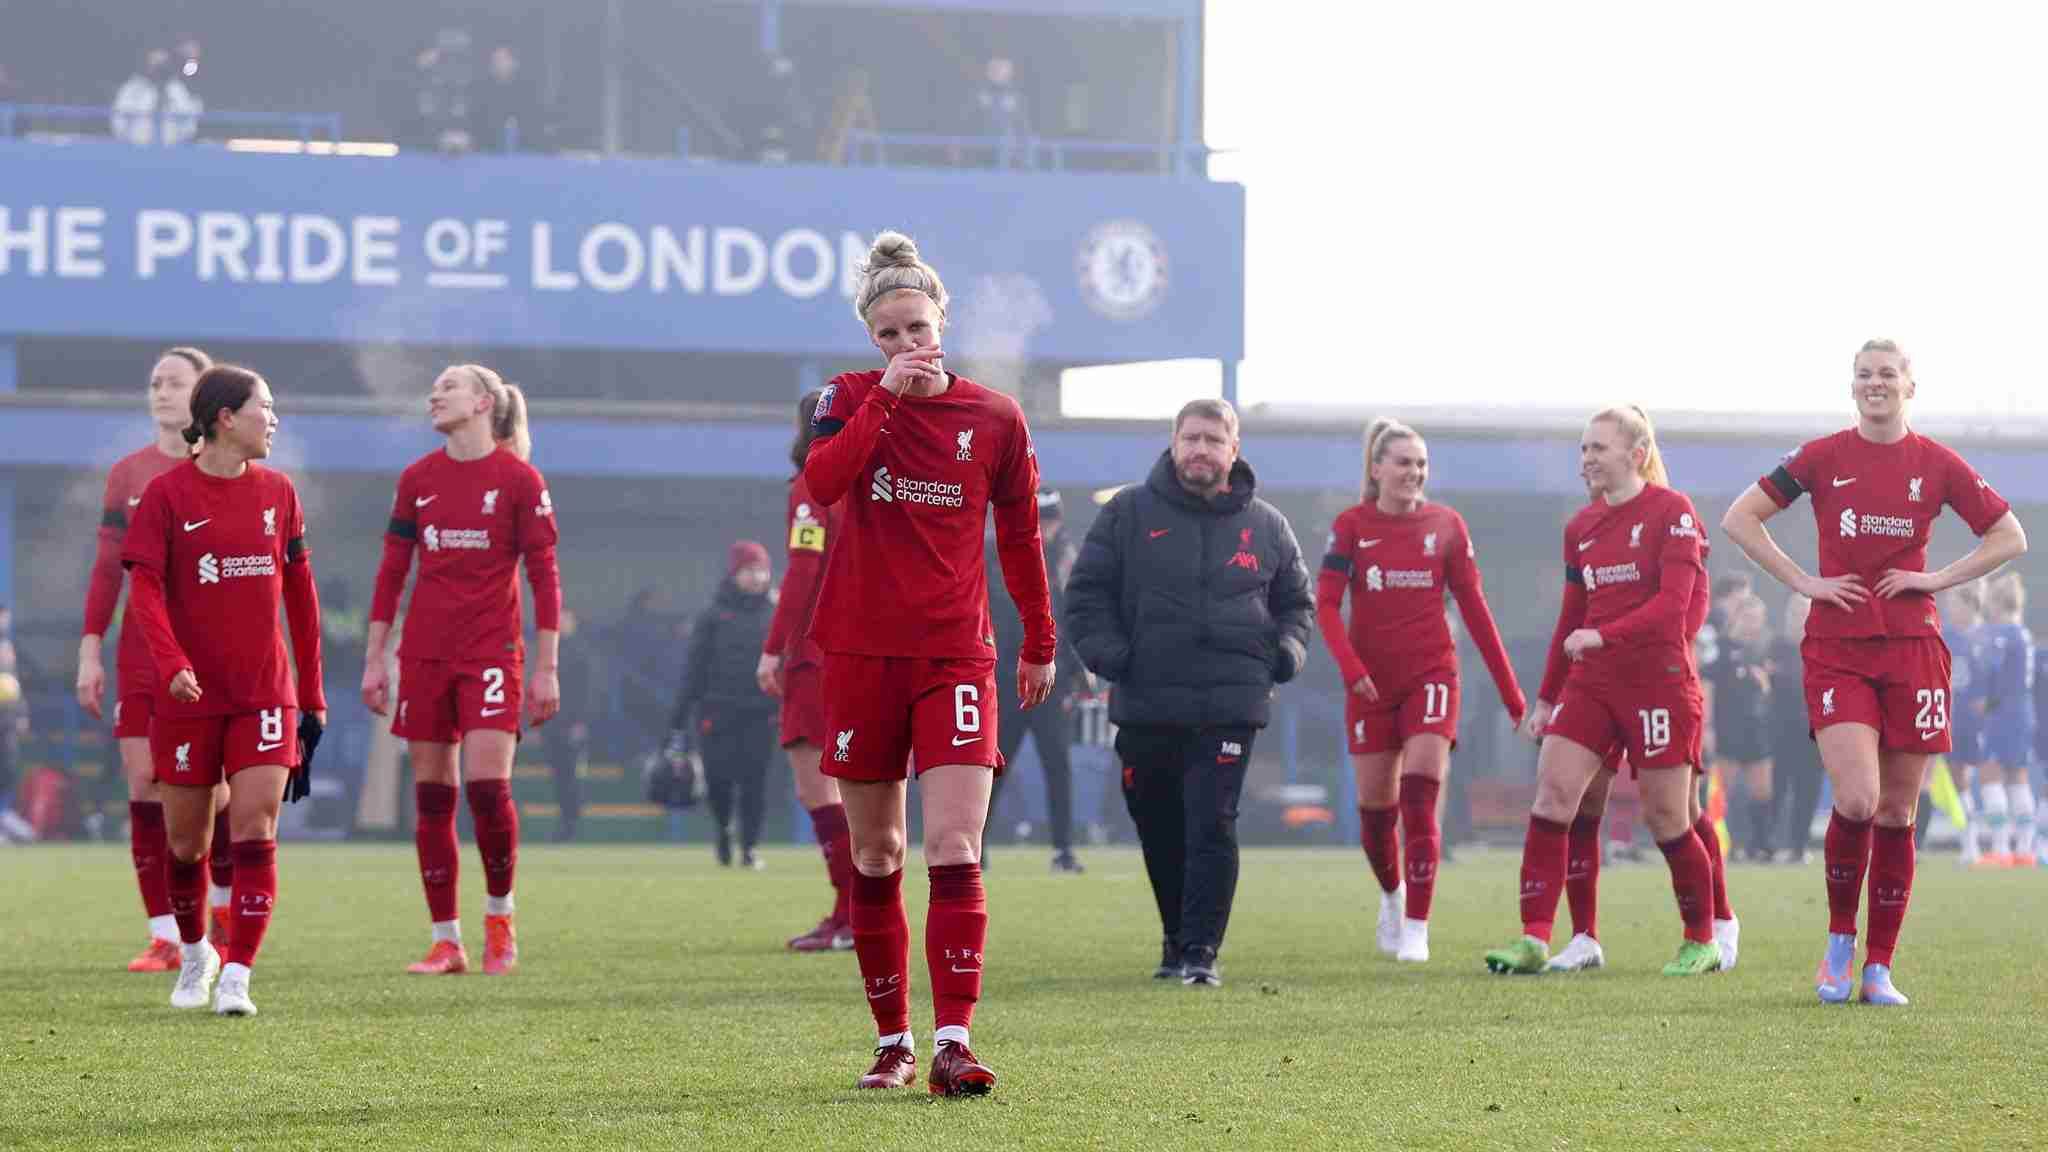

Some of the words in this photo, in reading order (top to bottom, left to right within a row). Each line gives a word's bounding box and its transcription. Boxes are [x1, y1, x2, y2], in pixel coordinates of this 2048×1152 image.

[136, 210, 399, 285] PRIDE
[425, 218, 508, 268] OF
[896, 477, 962, 496] standard
[896, 489, 963, 508] chartered
[801, 528, 815, 545] C
[1860, 524, 1914, 538] chartered
[1861, 513, 1913, 527] standard
[483, 667, 505, 704] 2
[1424, 683, 1449, 716] 11
[260, 707, 283, 741] 8
[955, 684, 980, 732] 6
[1915, 688, 1946, 729] 23
[1639, 708, 1671, 746] 18
[1221, 741, 1242, 755] MB
